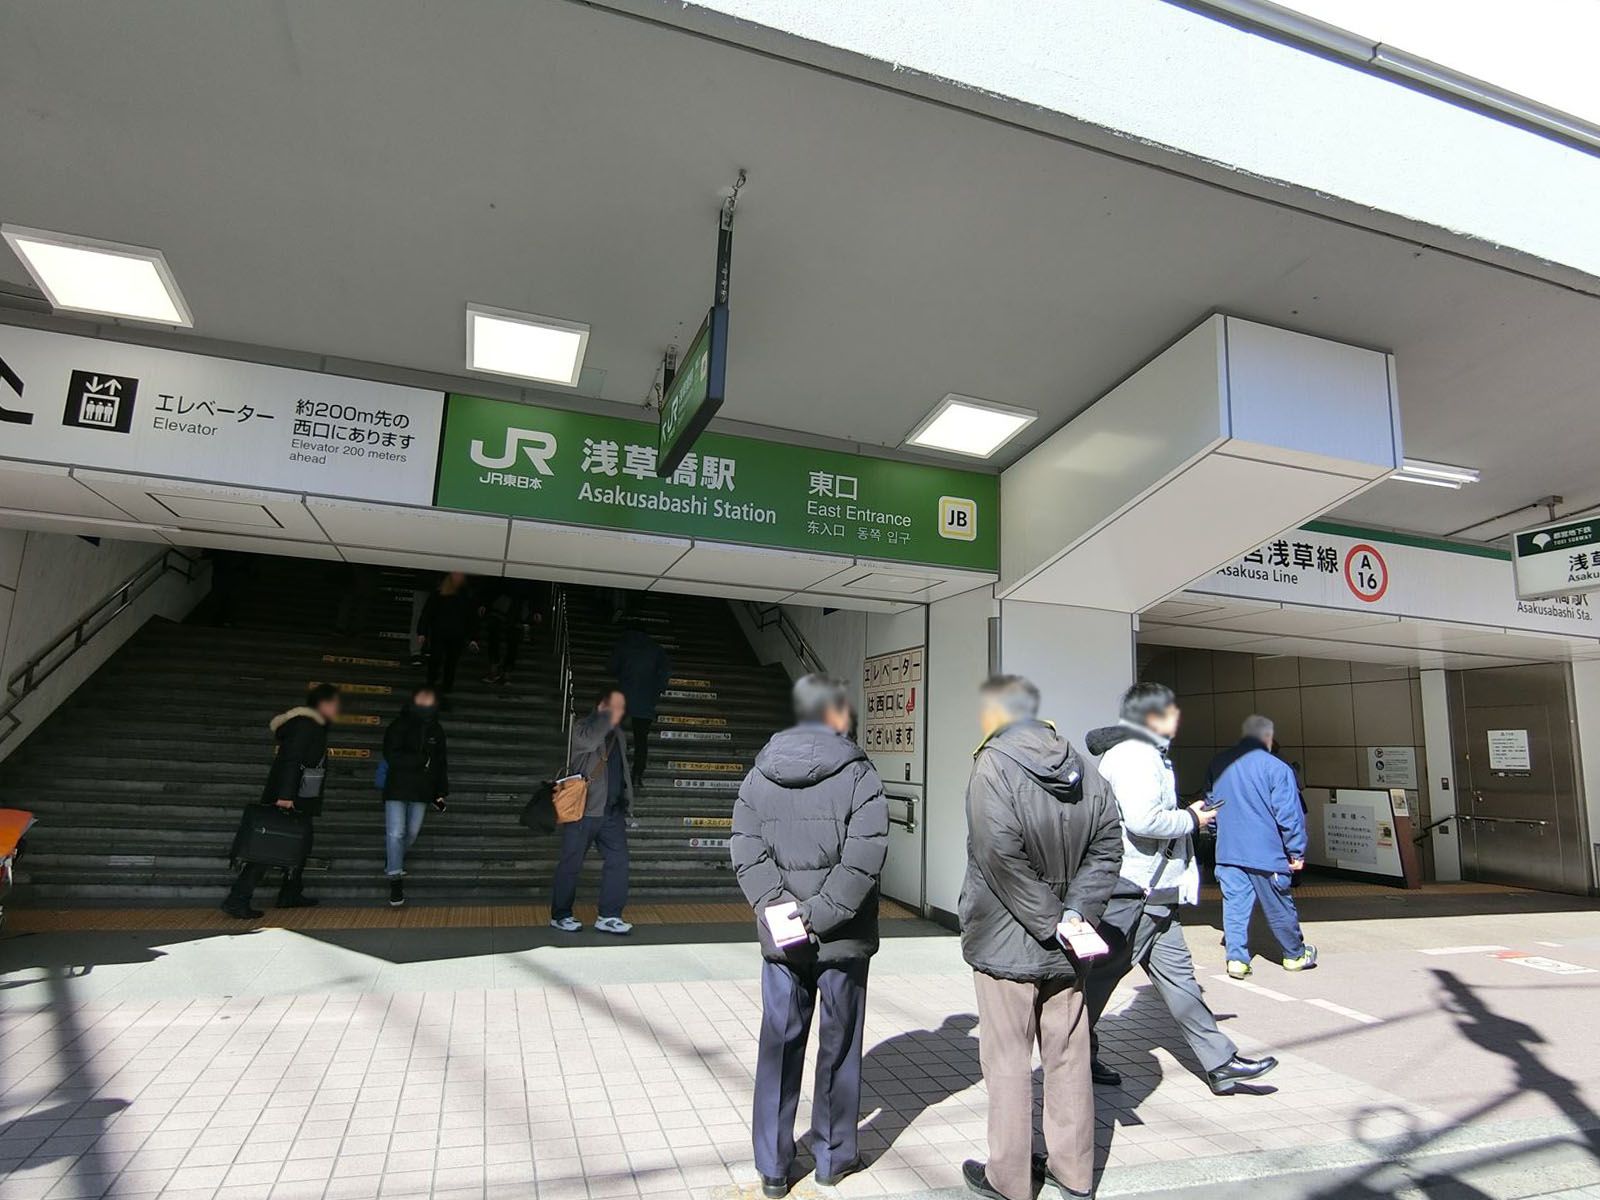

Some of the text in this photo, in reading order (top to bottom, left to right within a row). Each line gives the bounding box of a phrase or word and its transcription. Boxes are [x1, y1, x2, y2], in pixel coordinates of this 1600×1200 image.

[155, 394, 275, 423] エレベーター
[296, 399, 410, 429] 約200m先の
[153, 417, 218, 437] Elevator
[293, 419, 415, 450] 西口にあります
[289, 451, 327, 465] ahead
[291, 439, 407, 463] Elevator 200 meters
[470, 427, 558, 477] JR
[479, 472, 543, 490] JR東日本
[808, 471, 858, 500] 東口
[578, 482, 777, 524] Asakusabashi Station
[807, 500, 912, 527] East Entrance
[947, 510, 968, 527] JB
[807, 520, 845, 537] 东入口
[886, 530, 911, 545] 입구
[1360, 554, 1372, 570] A
[1273, 569, 1298, 585] Line
[1357, 571, 1378, 590] 16
[1517, 601, 1593, 621] Asakusabashi Sta.
[865, 658, 920, 682] エレベーター
[868, 694, 904, 713] は西口に
